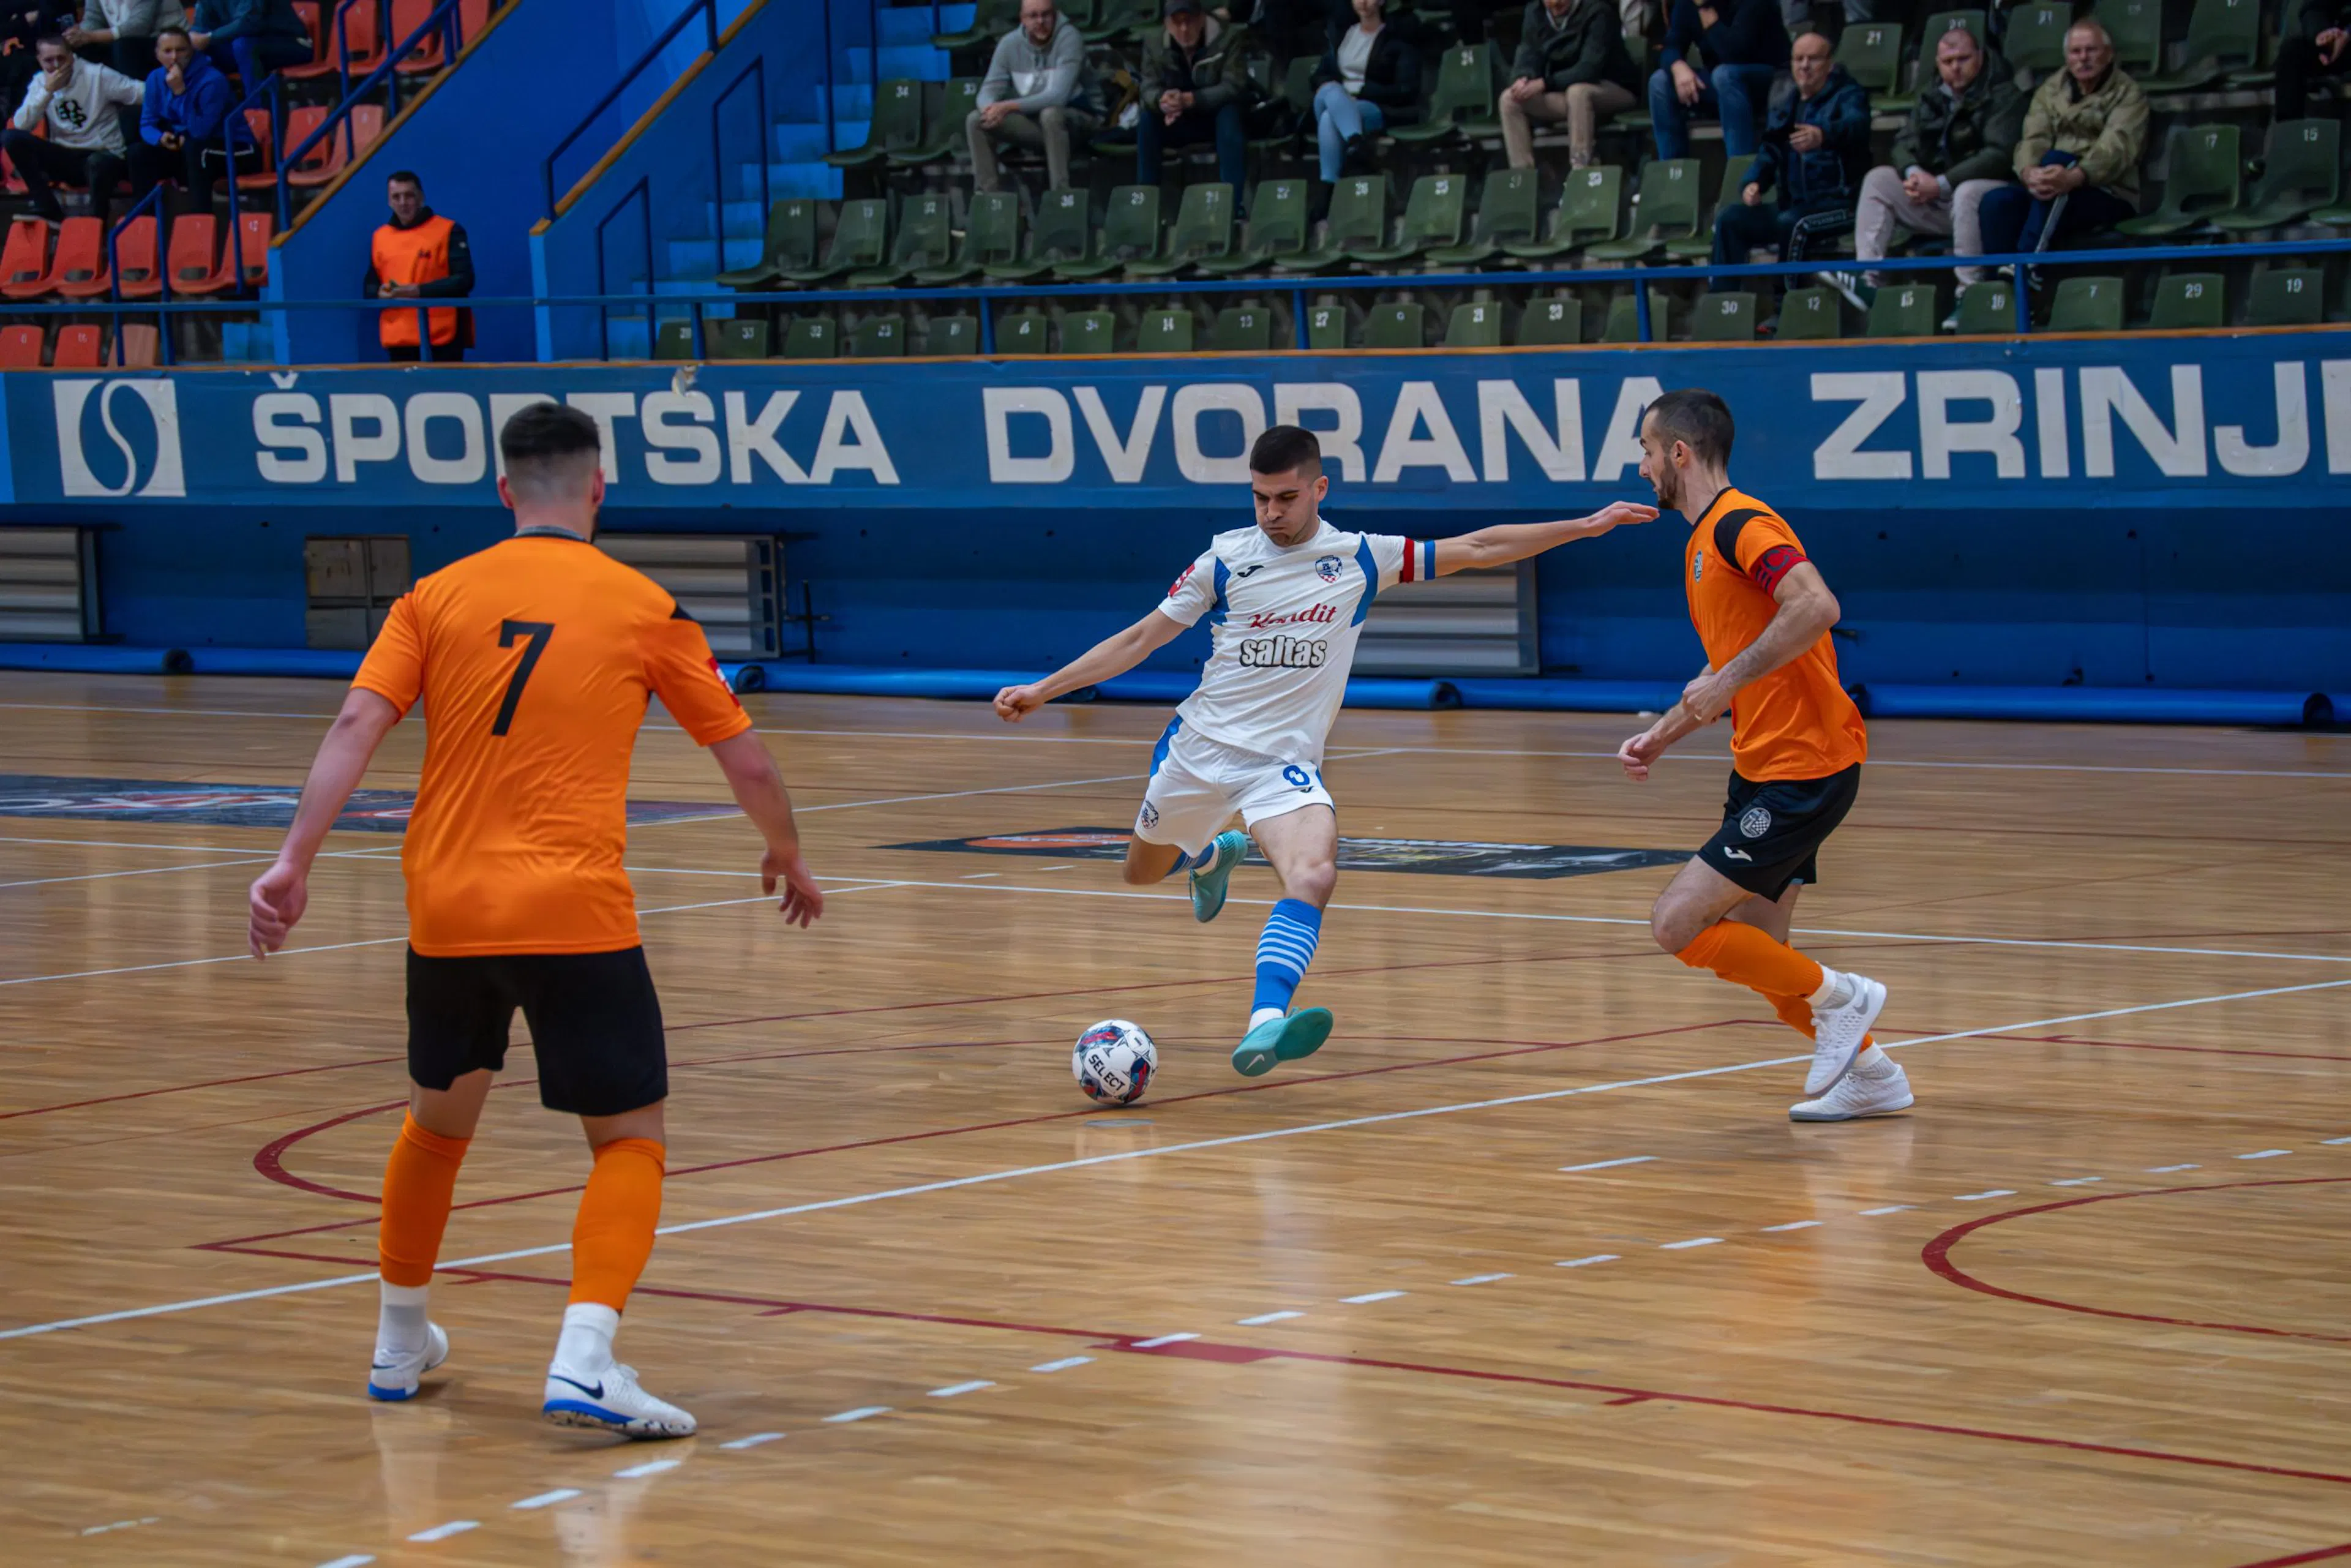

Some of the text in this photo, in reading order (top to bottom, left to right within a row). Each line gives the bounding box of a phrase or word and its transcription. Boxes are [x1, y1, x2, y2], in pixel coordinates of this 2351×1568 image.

[2089, 284, 2099, 299] 7
[2185, 283, 2203, 298] 29
[1721, 300, 1738, 315] 30
[1807, 296, 1820, 311] 12
[983, 376, 1665, 484] DVORANA
[1239, 635, 1328, 667] saltas
[492, 619, 555, 736] 7
[1089, 1054, 1125, 1091] SELECT
